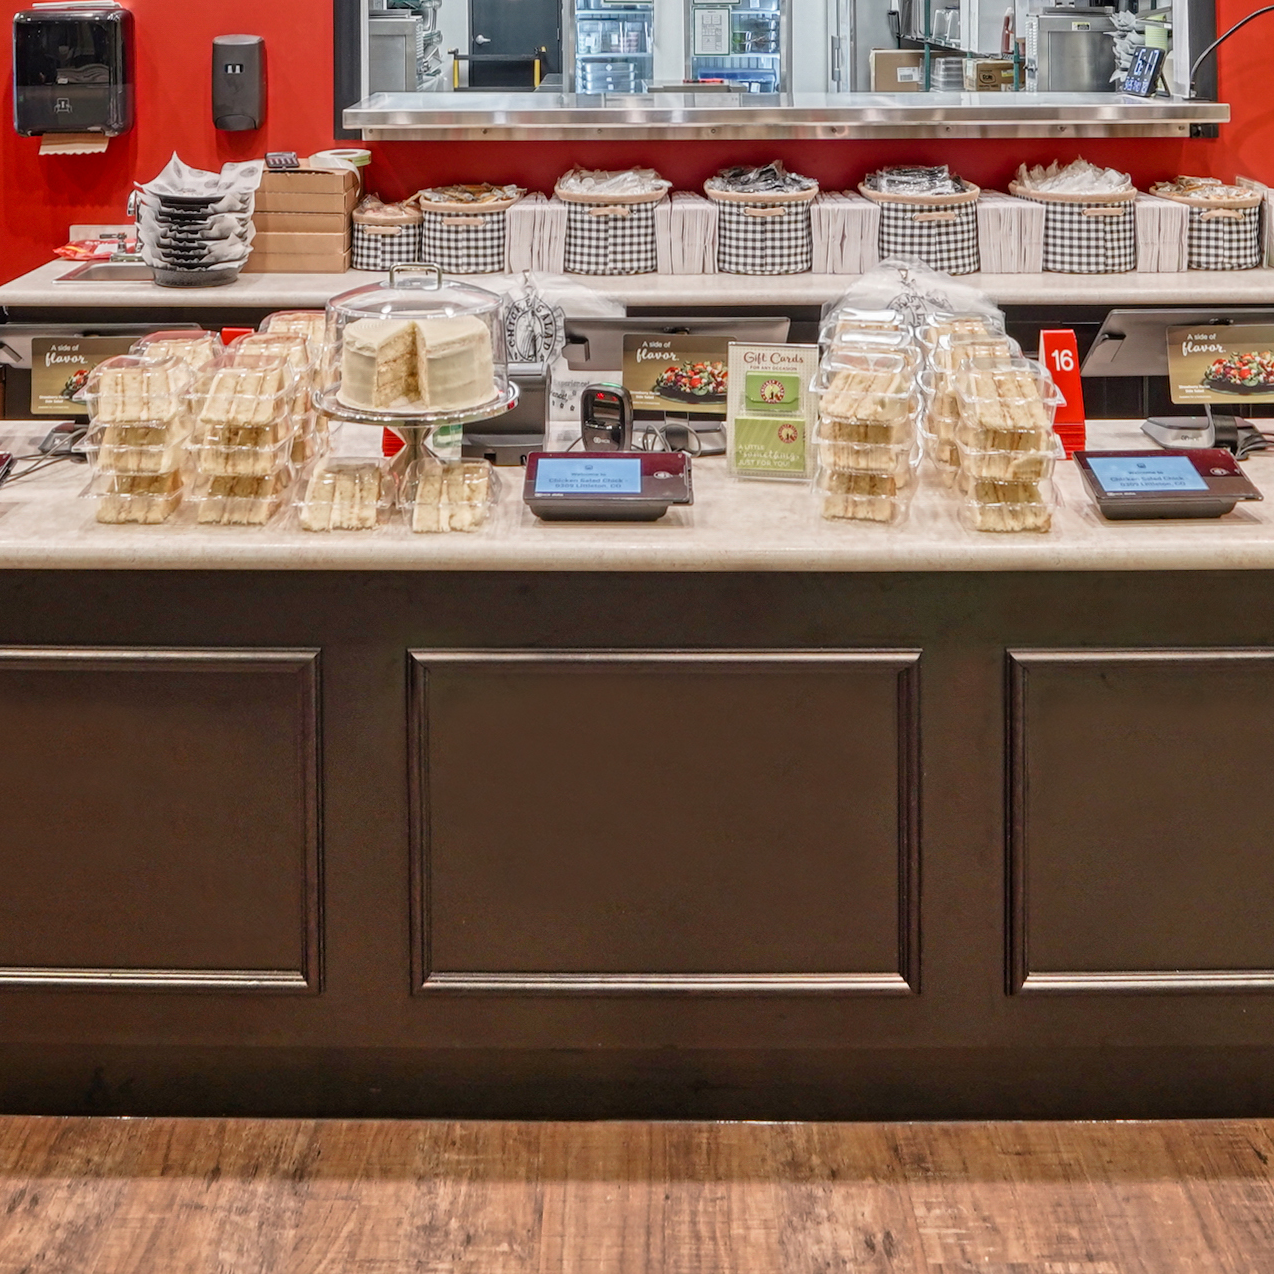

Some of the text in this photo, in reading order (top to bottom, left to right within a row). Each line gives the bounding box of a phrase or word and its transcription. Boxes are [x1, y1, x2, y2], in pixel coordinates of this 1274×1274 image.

[663, 340, 671, 348] of
[744, 351, 804, 364] Gift Cards
[1051, 349, 1074, 371] 16
